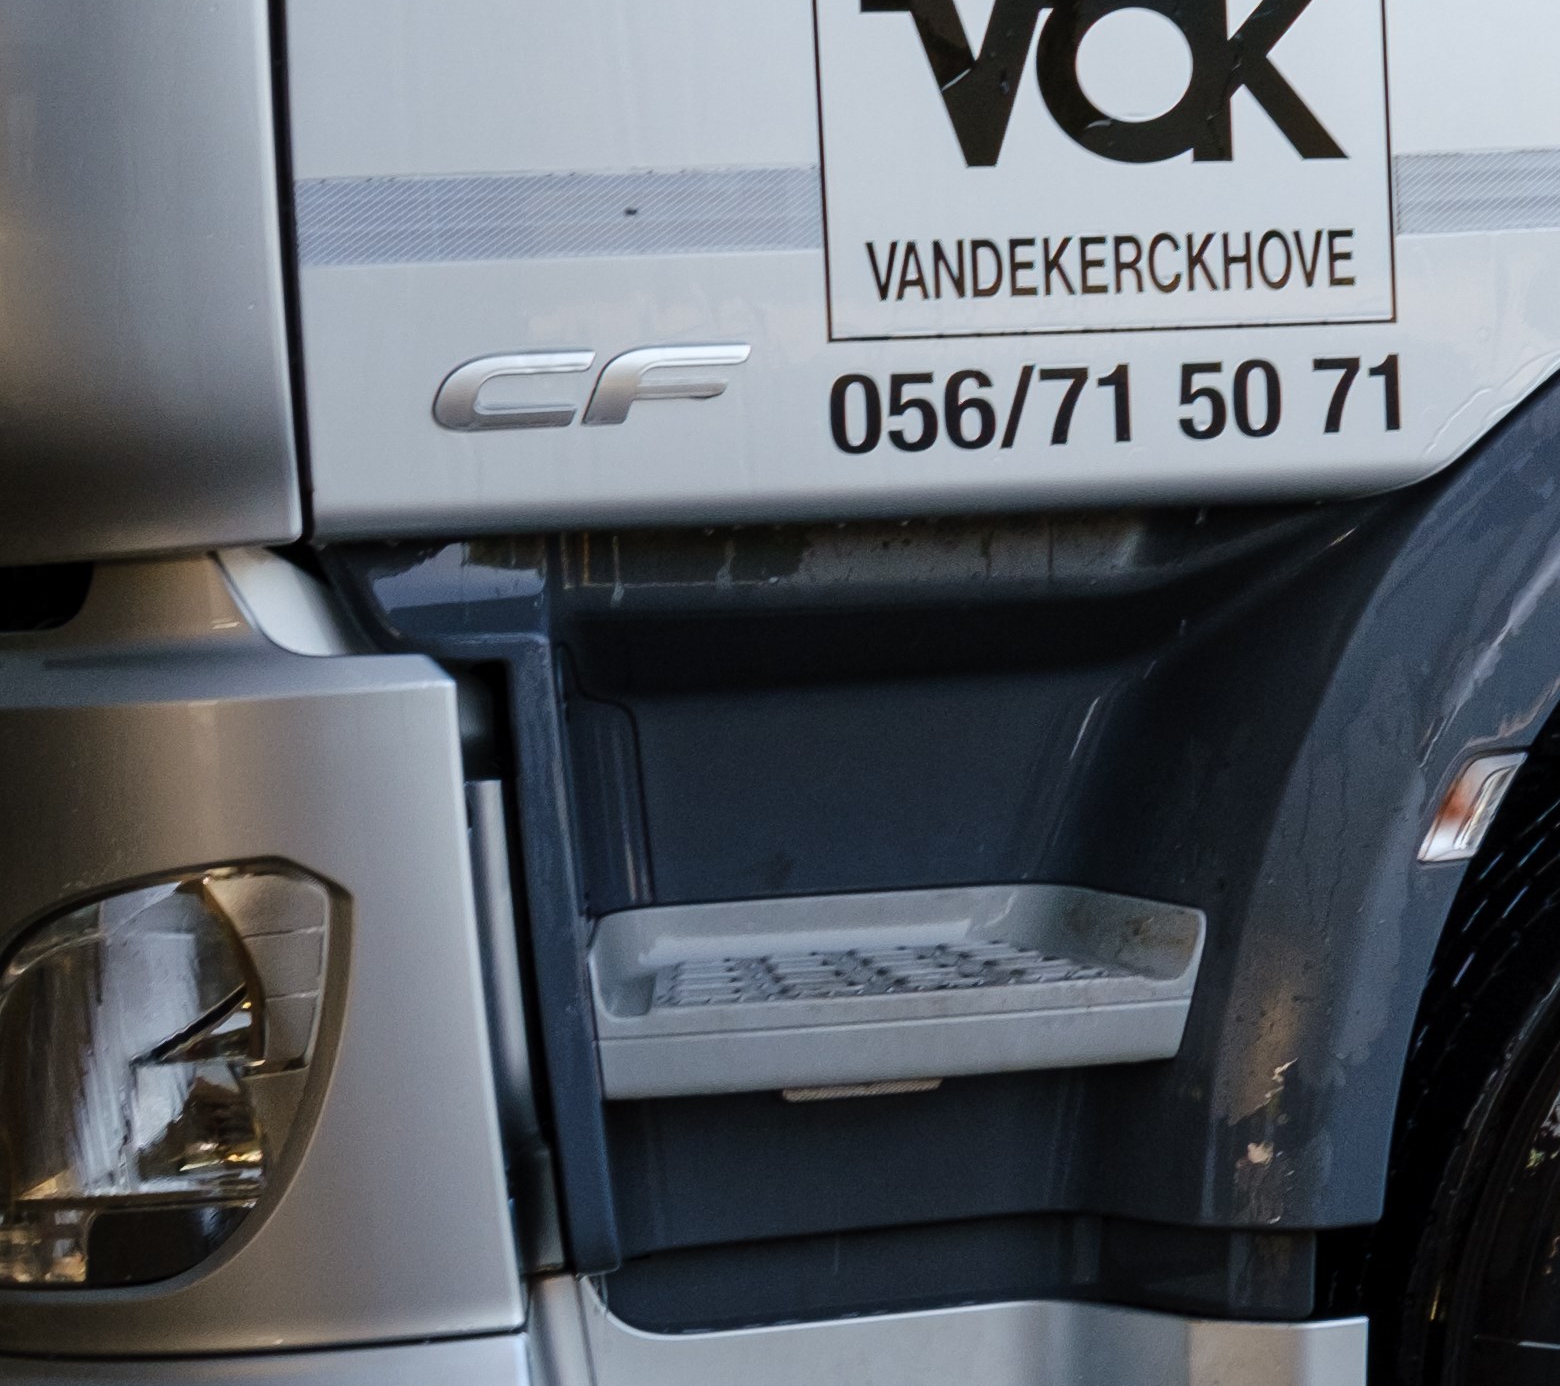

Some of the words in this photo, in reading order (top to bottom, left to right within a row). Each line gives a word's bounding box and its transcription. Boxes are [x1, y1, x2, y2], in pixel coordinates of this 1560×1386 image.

[864, 227, 1357, 303] VANDEKERCKHOVE
[431, 342, 752, 432] CF
[827, 362, 1134, 456] 056/71
[1177, 357, 1282, 443] 50
[1311, 352, 1402, 435] 71
